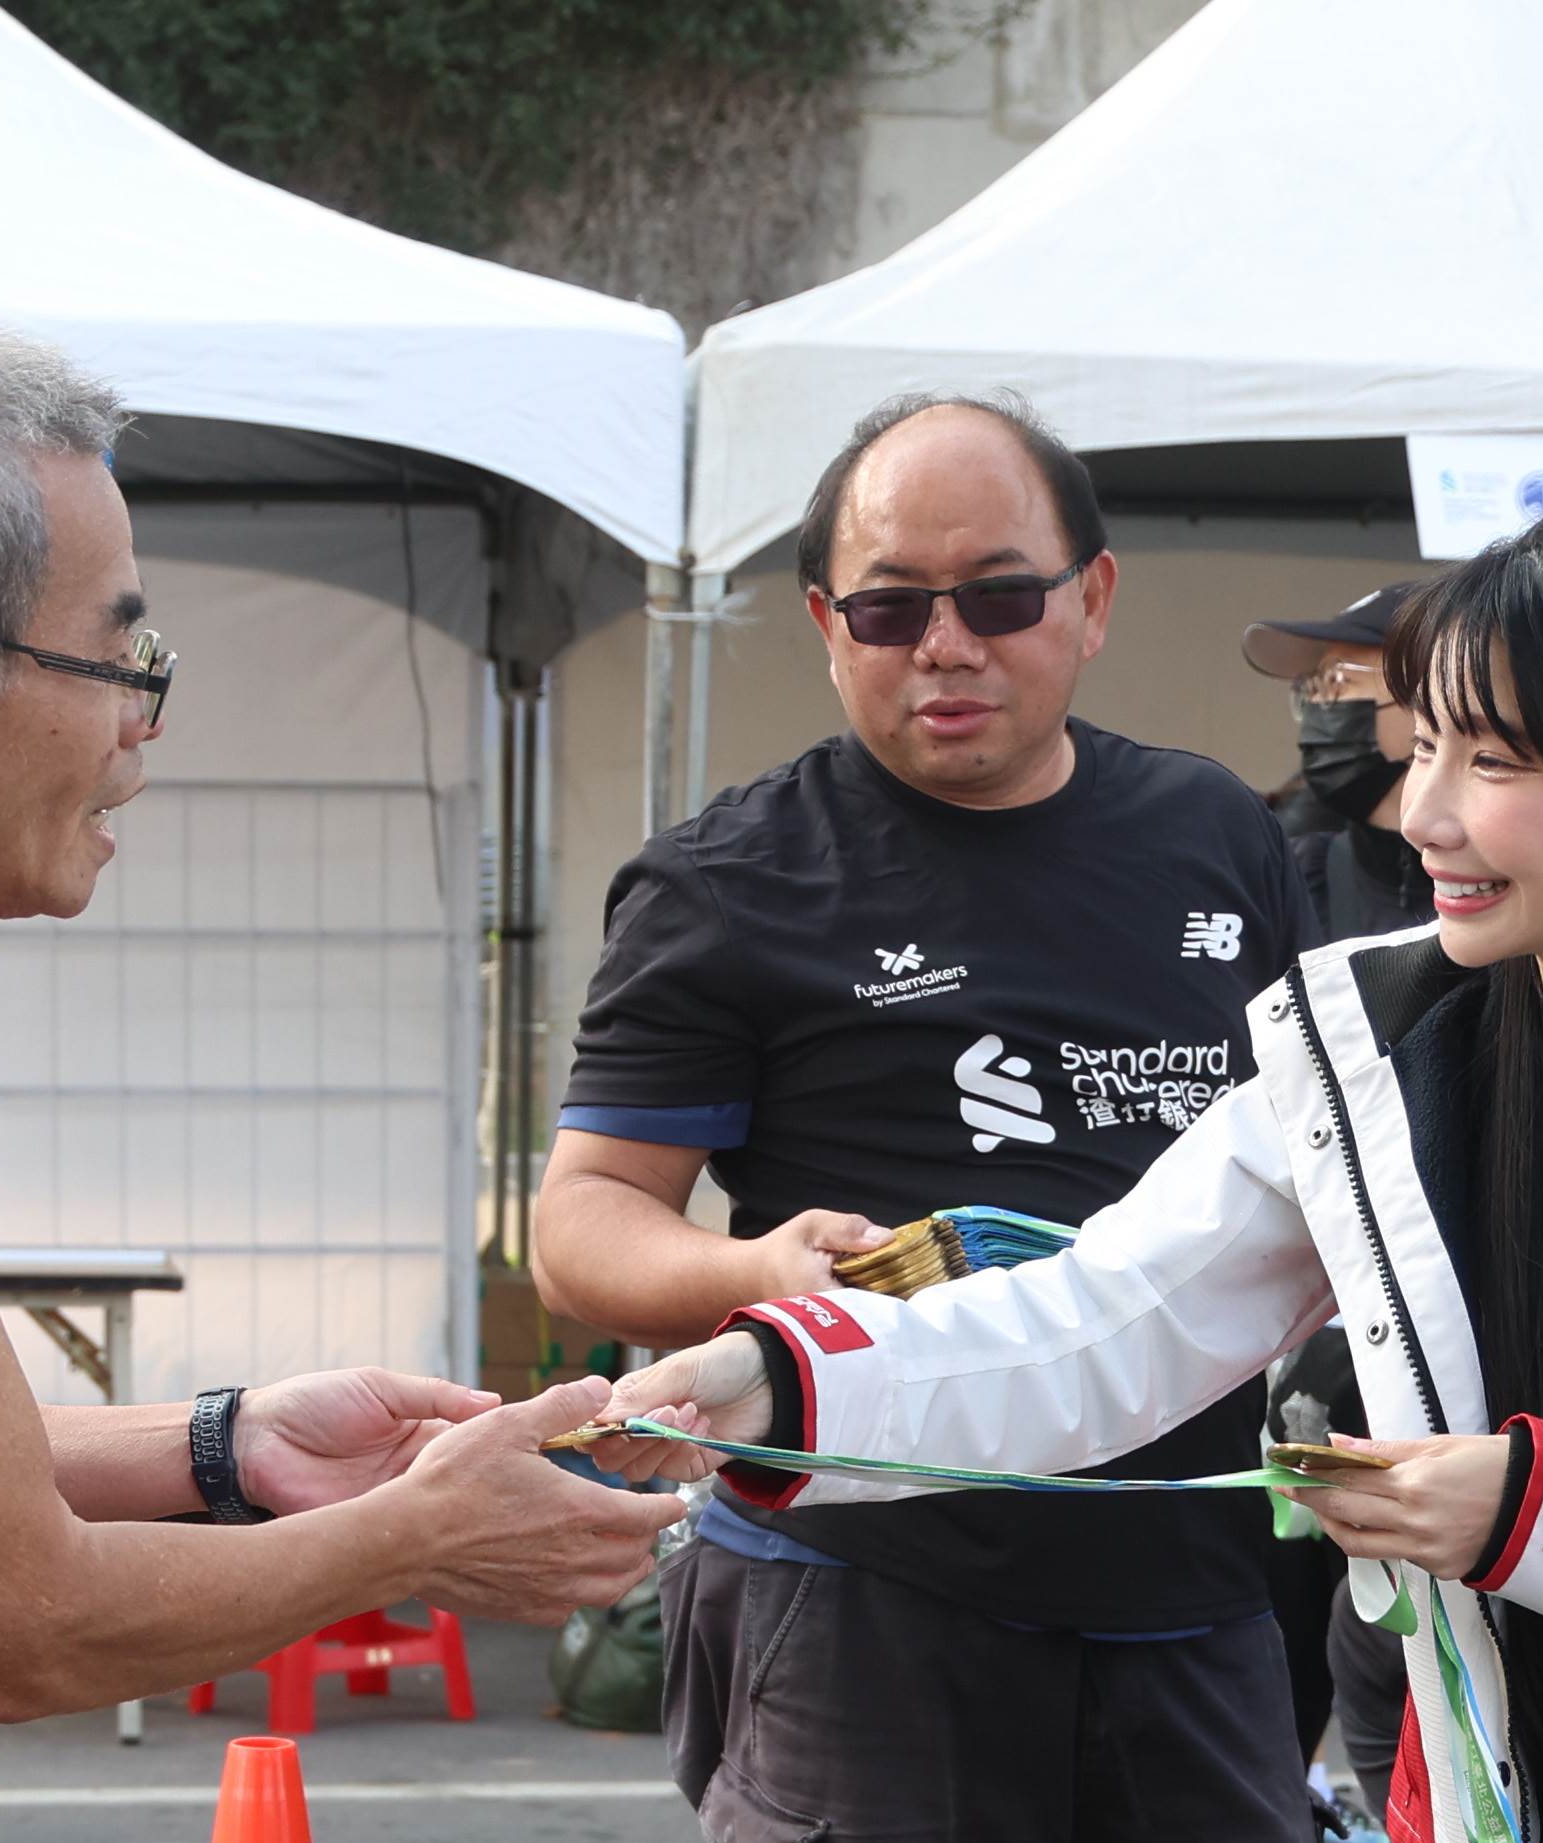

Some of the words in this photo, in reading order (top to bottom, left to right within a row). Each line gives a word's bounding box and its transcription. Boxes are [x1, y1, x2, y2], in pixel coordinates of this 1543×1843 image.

[853, 965, 968, 999] futuremakers
[872, 998, 884, 1008] by
[884, 990, 921, 1005] Standard
[922, 982, 960, 997] Chartered
[1060, 1039, 1228, 1077] sndard
[1076, 1097, 1198, 1132] 渣打銀
